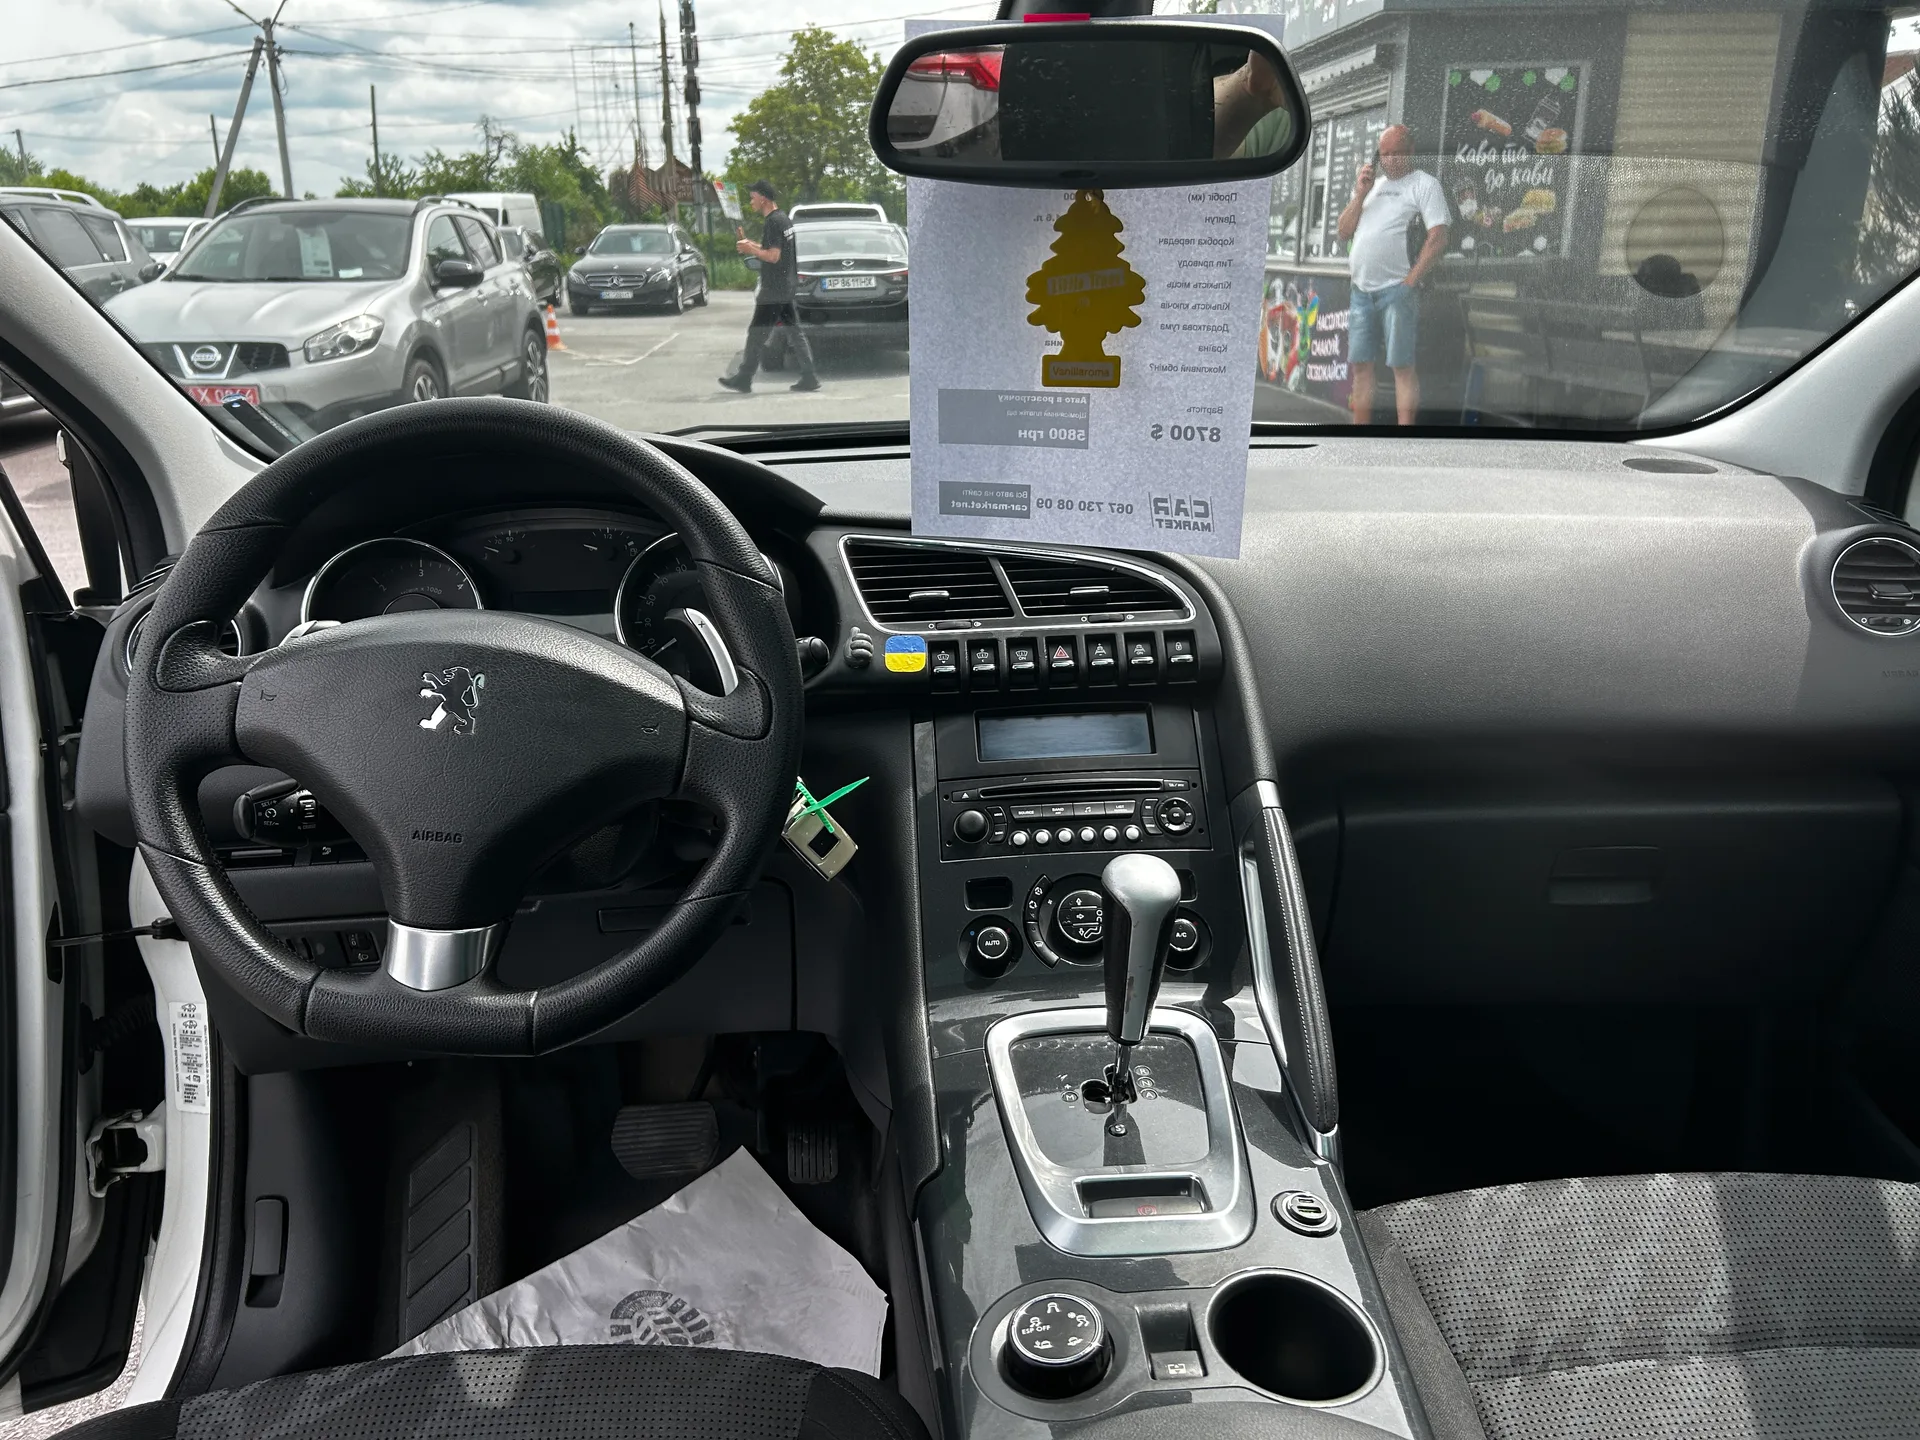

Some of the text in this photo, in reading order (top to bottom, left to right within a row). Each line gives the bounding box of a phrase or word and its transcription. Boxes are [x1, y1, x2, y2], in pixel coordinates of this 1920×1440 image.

[1052, 365, 1110, 377] Vanillaroma
[418, 569, 425, 577] 3
[675, 564, 688, 574] 90
[658, 577, 669, 587] 70
[379, 584, 387, 592] 2
[646, 594, 657, 607] 50
[644, 617, 652, 628] 30
[647, 638, 657, 650] 10
[412, 830, 463, 843] AIRBAG
[1021, 1327, 1034, 1335] ESP
